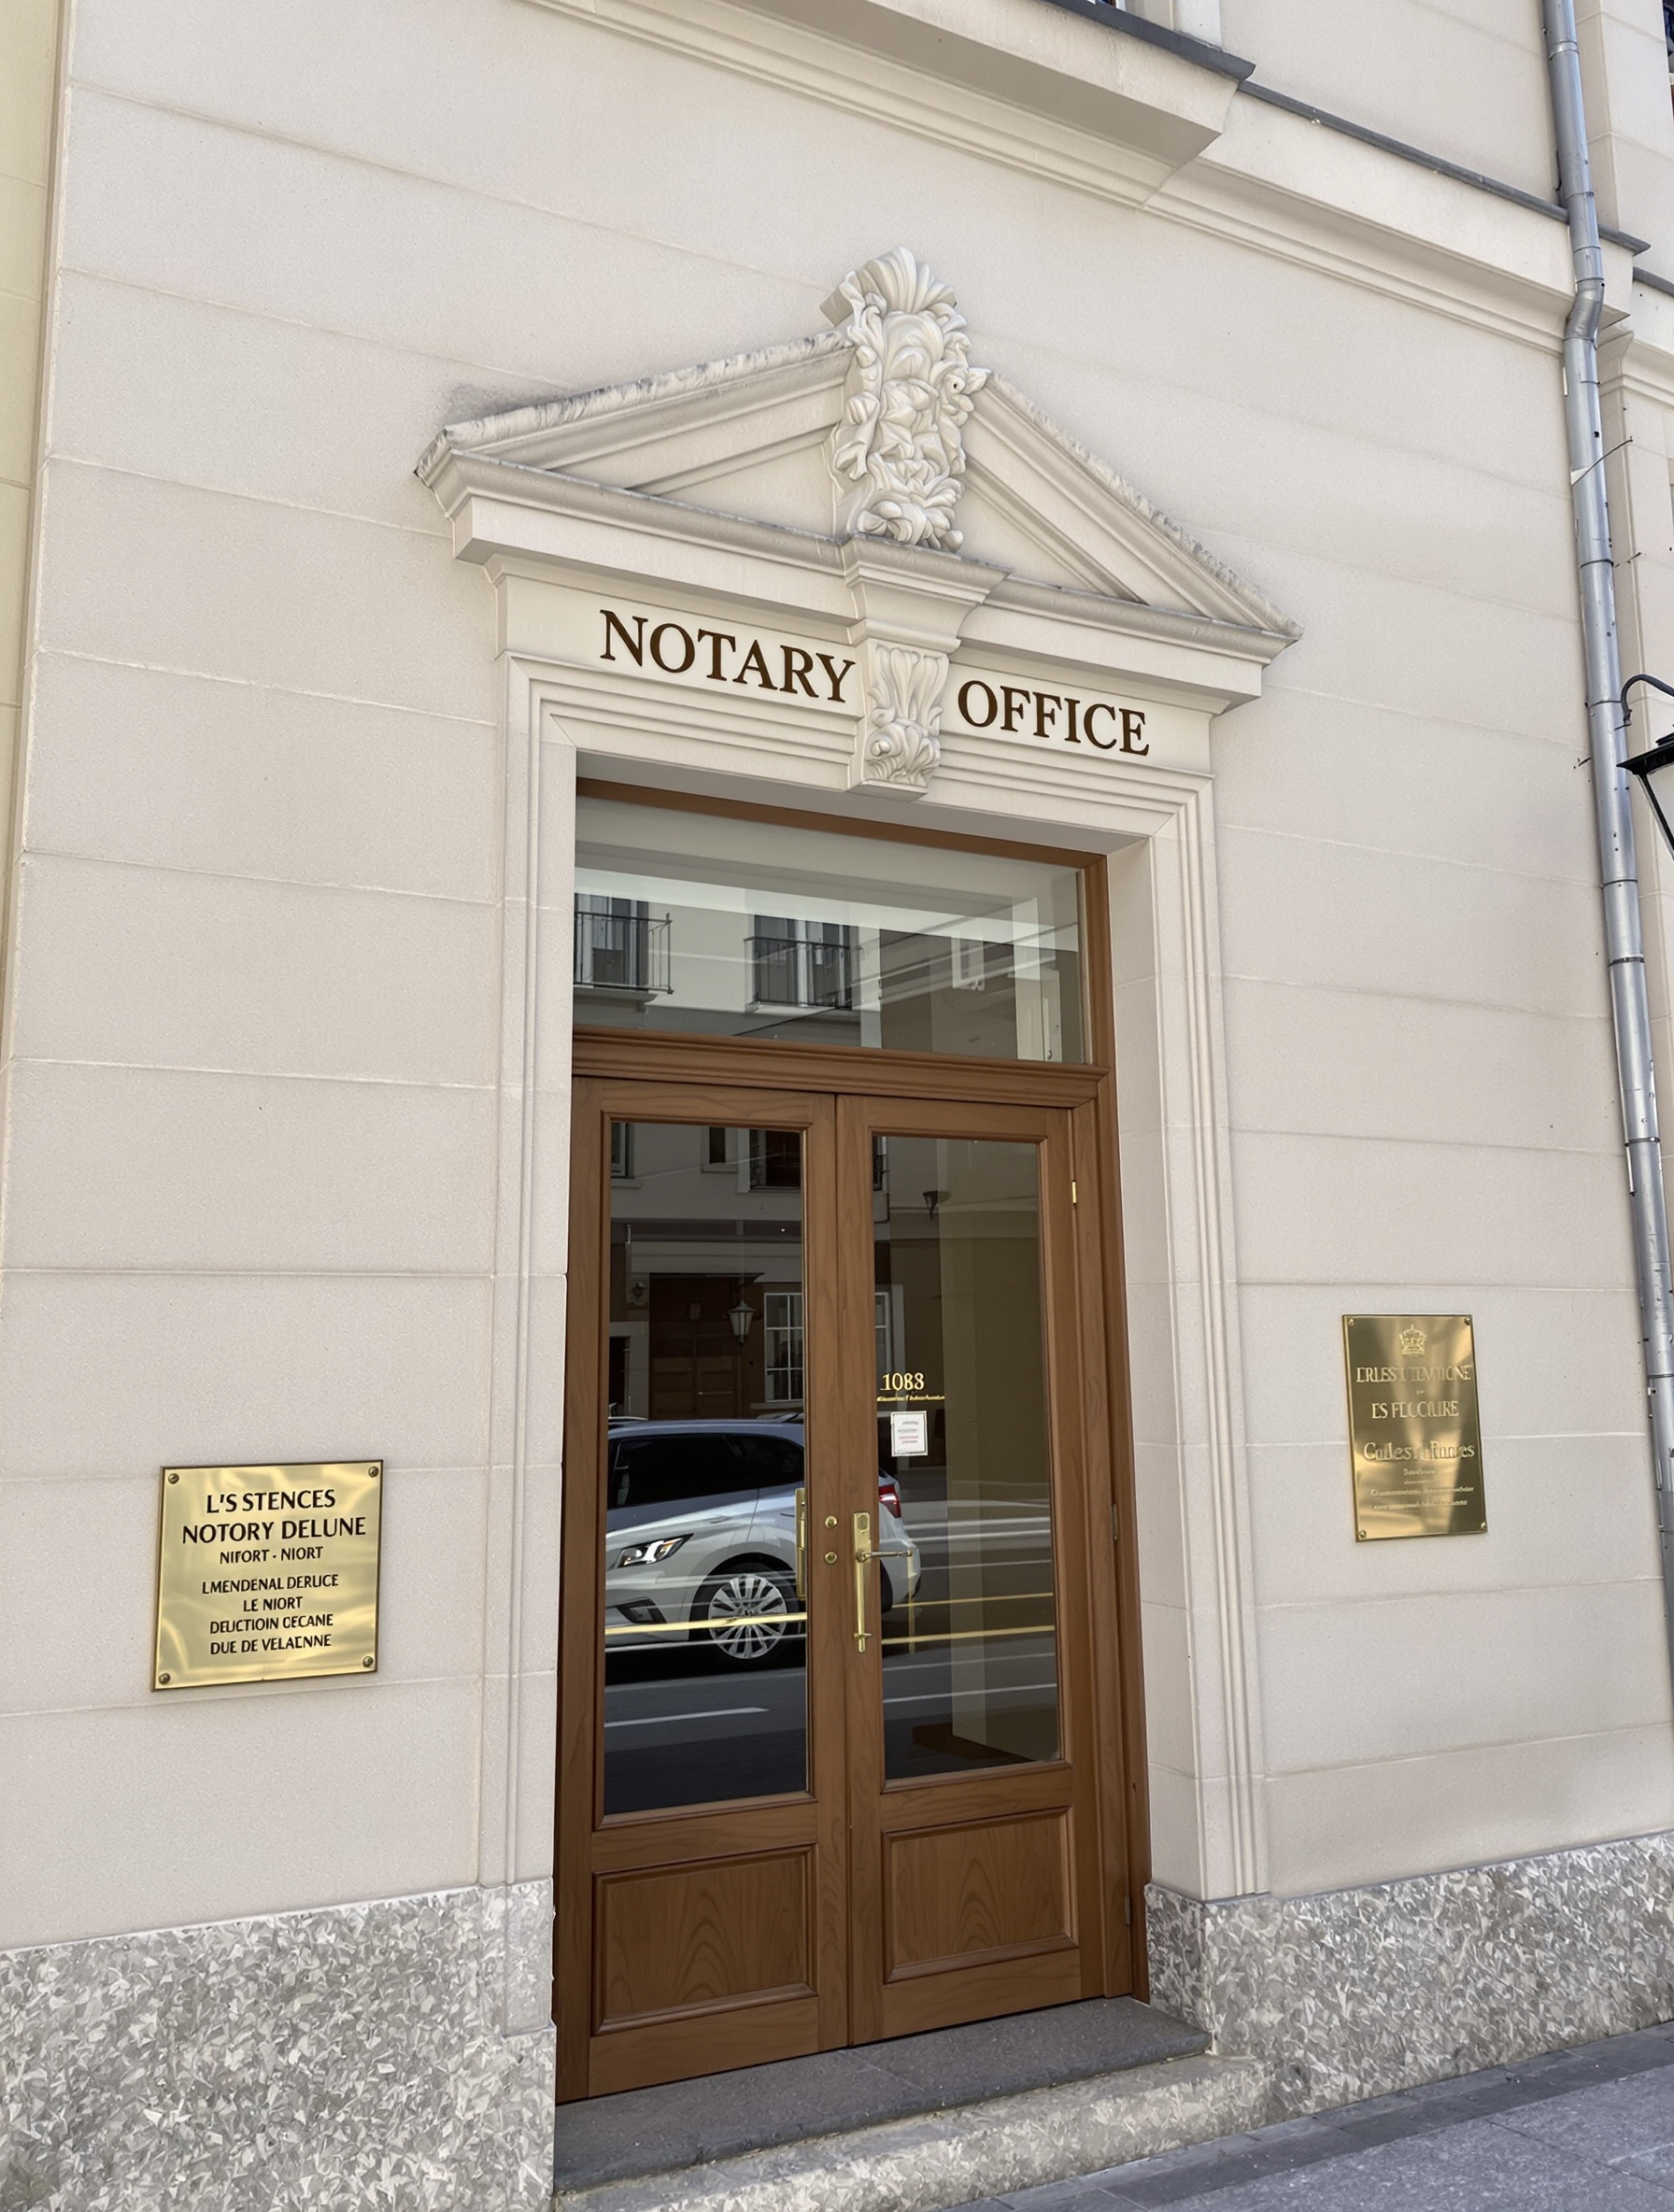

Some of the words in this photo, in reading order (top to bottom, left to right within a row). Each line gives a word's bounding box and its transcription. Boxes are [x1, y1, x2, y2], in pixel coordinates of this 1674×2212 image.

[599, 609, 856, 703] NOTARY
[958, 679, 1150, 756] OFFICE
[206, 1494, 237, 1513] L'S
[242, 1489, 336, 1511] STENCES
[182, 1521, 275, 1544] NOTORY
[281, 1517, 366, 1539] DELUNE
[280, 1546, 323, 1561] NIORT
[243, 1598, 259, 1612] LE
[262, 1596, 304, 1611] NIORT
[210, 1640, 237, 1655] DUE
[241, 1638, 259, 1652] DE
